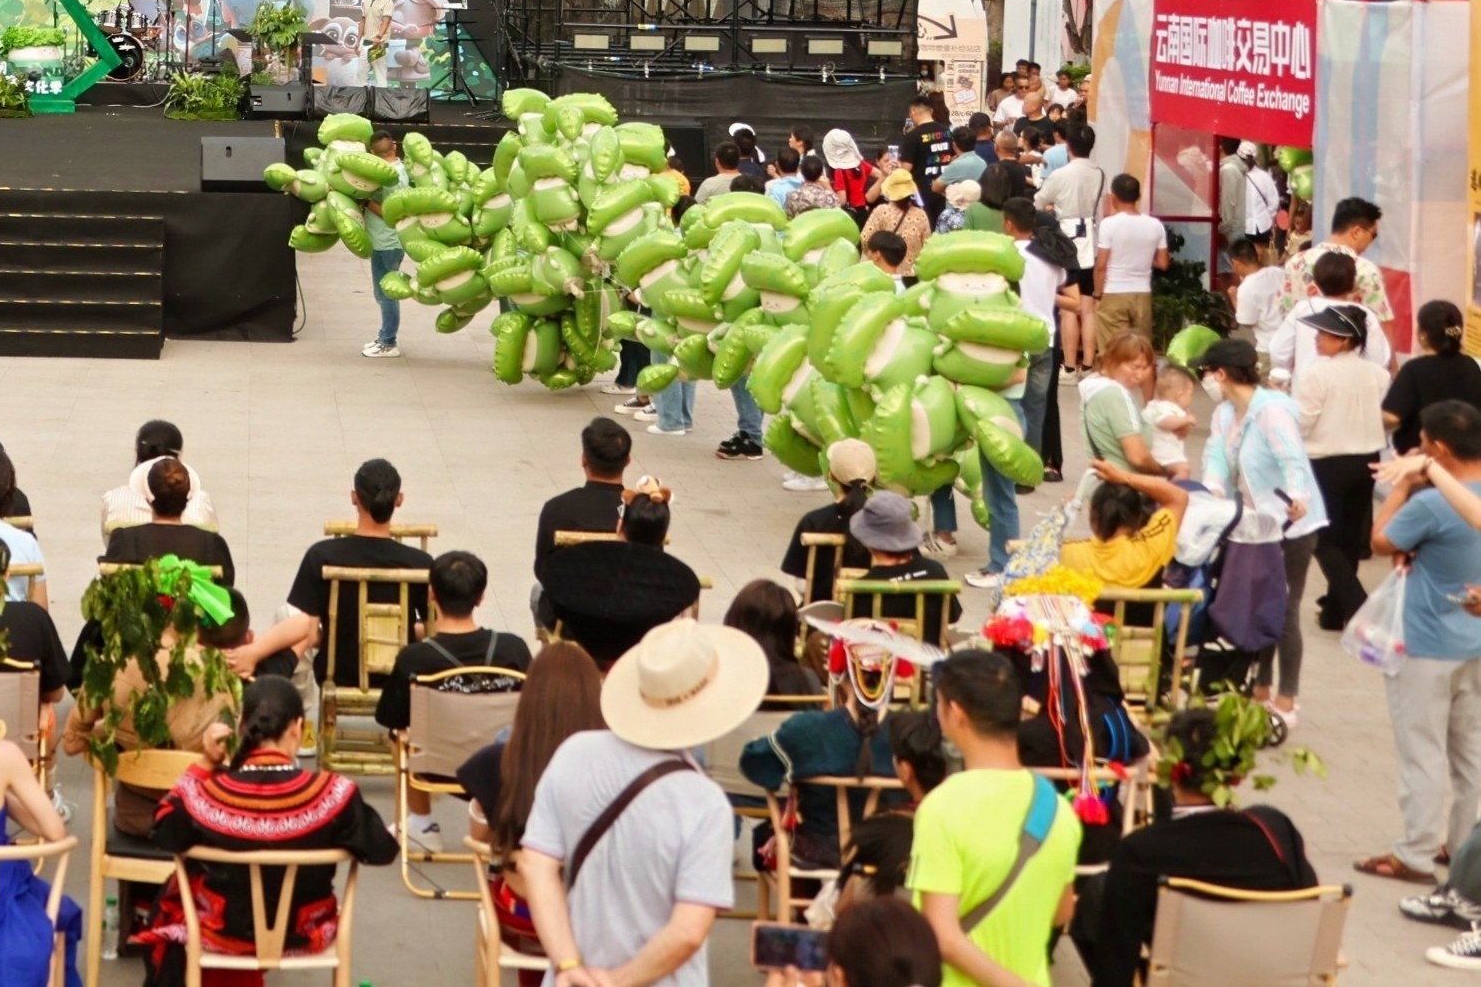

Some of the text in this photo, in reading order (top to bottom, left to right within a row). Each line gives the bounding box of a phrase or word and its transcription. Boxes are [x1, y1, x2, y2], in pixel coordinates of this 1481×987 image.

[1155, 13, 1312, 80] 云南国际咖啡交易中心
[1154, 69, 1310, 120] Yunnan International Coffee Exchange
